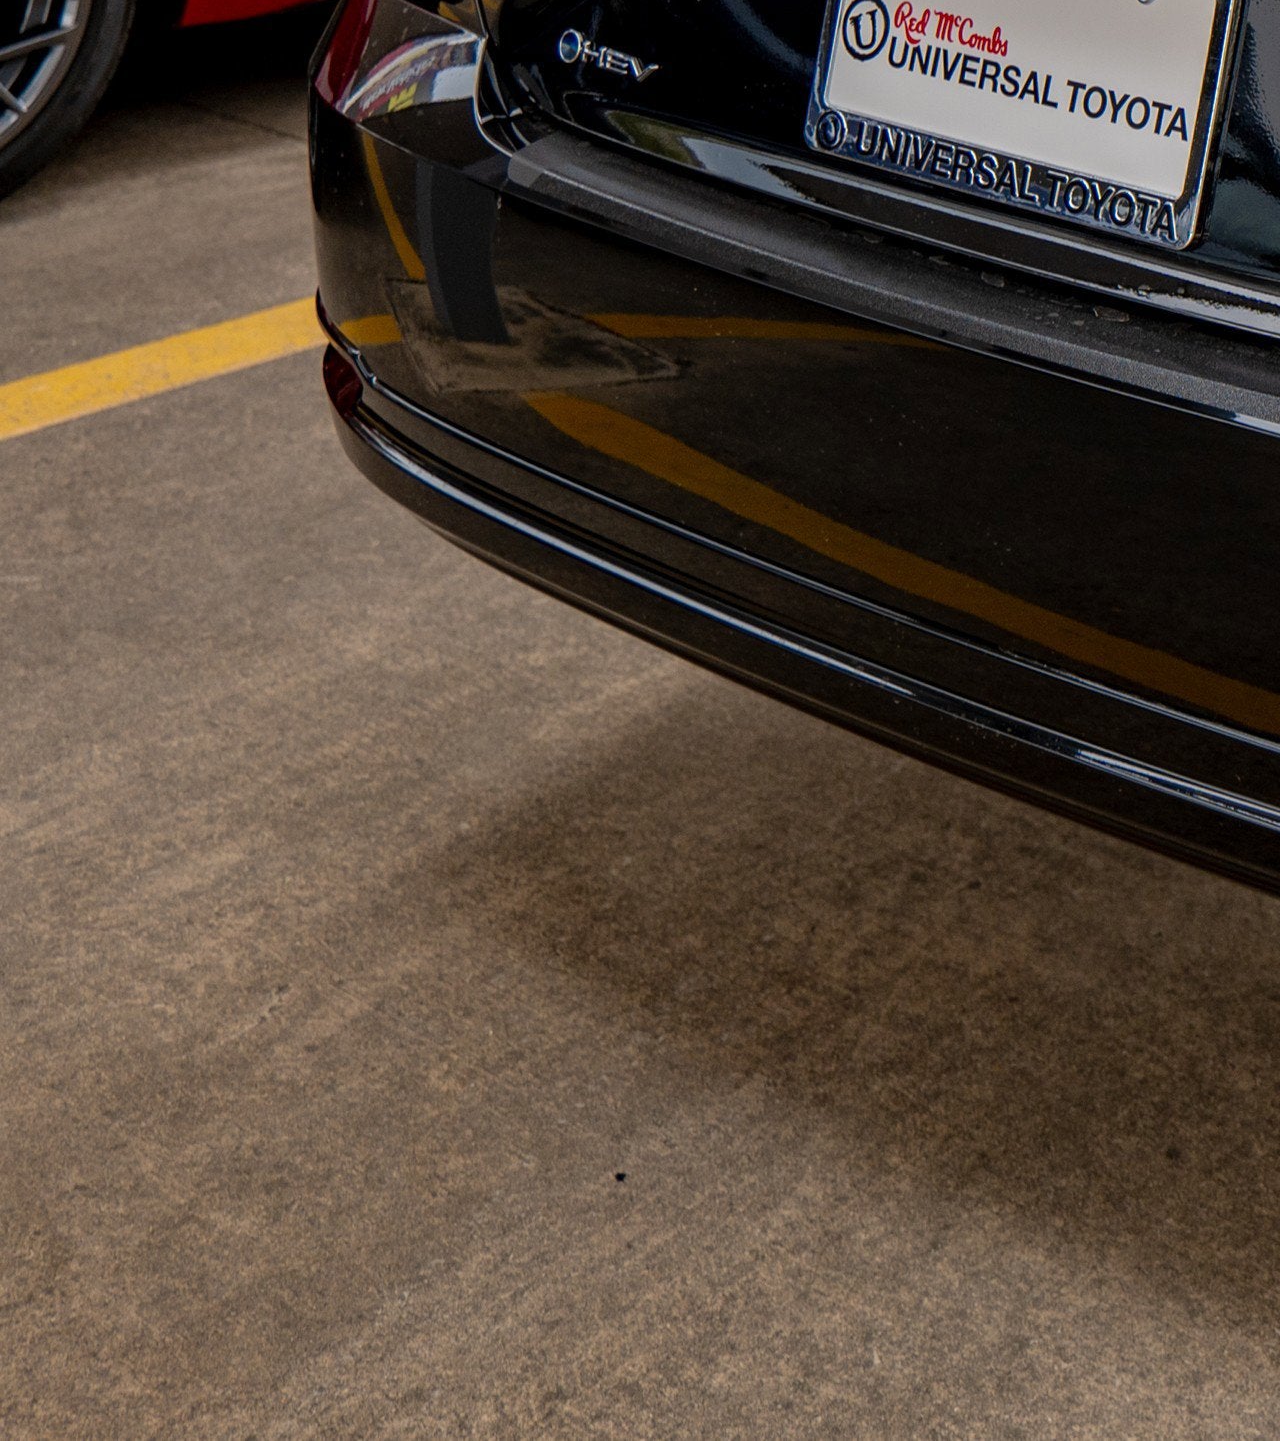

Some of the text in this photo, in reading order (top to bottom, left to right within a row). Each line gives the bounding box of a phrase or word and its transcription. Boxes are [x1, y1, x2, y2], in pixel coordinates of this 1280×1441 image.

[581, 40, 660, 83] HEV
[894, 1, 1009, 57] Red McCombs
[888, 36, 1190, 142] UNIVERSAL TOYOTA
[855, 120, 1040, 206] UNIVERSAL
[1045, 169, 1181, 243] TOYOTA
